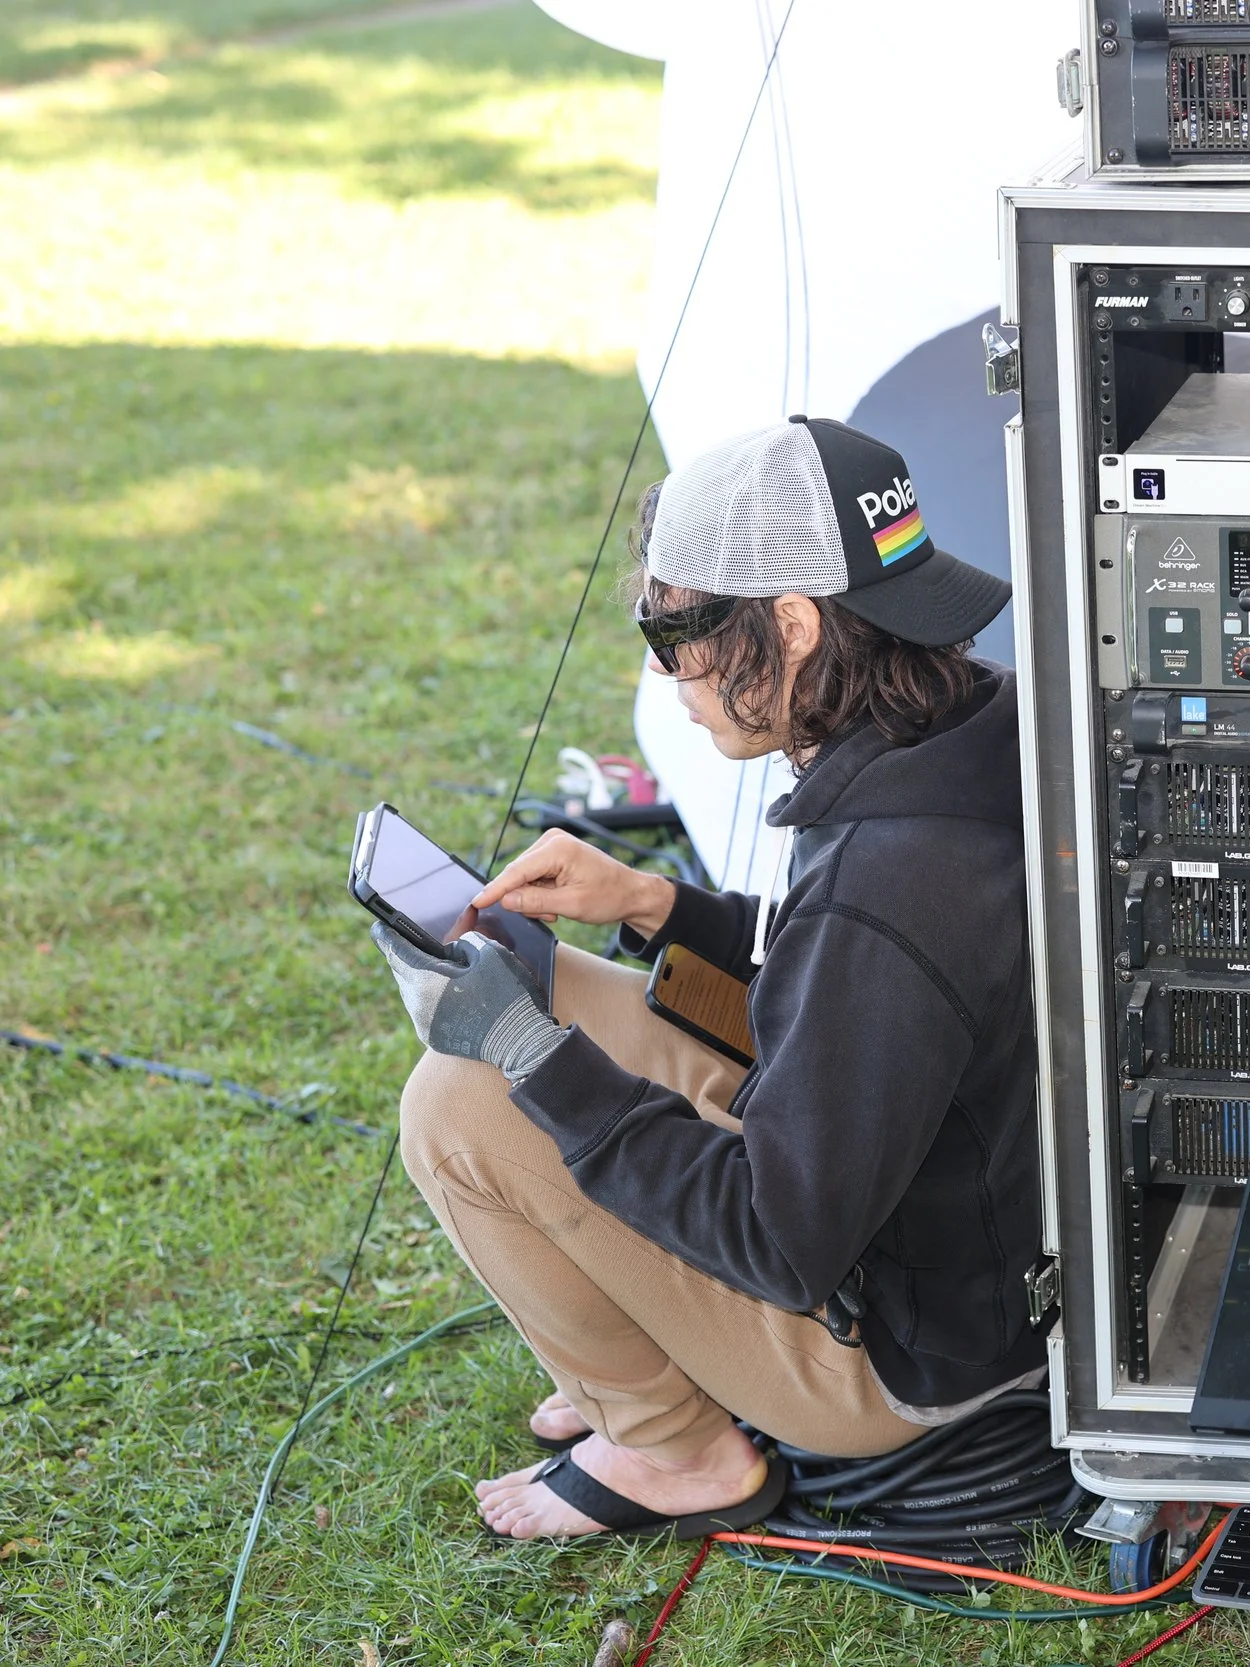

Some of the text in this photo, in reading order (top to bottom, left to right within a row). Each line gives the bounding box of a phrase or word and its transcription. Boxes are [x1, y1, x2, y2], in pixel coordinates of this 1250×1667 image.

[1095, 297, 1149, 307] FURMAN
[1159, 561, 1200, 570] behringer
[1184, 704, 1205, 720] lake
[904, 1478, 1020, 1509] SERIES MULTI-CONDUCTOR
